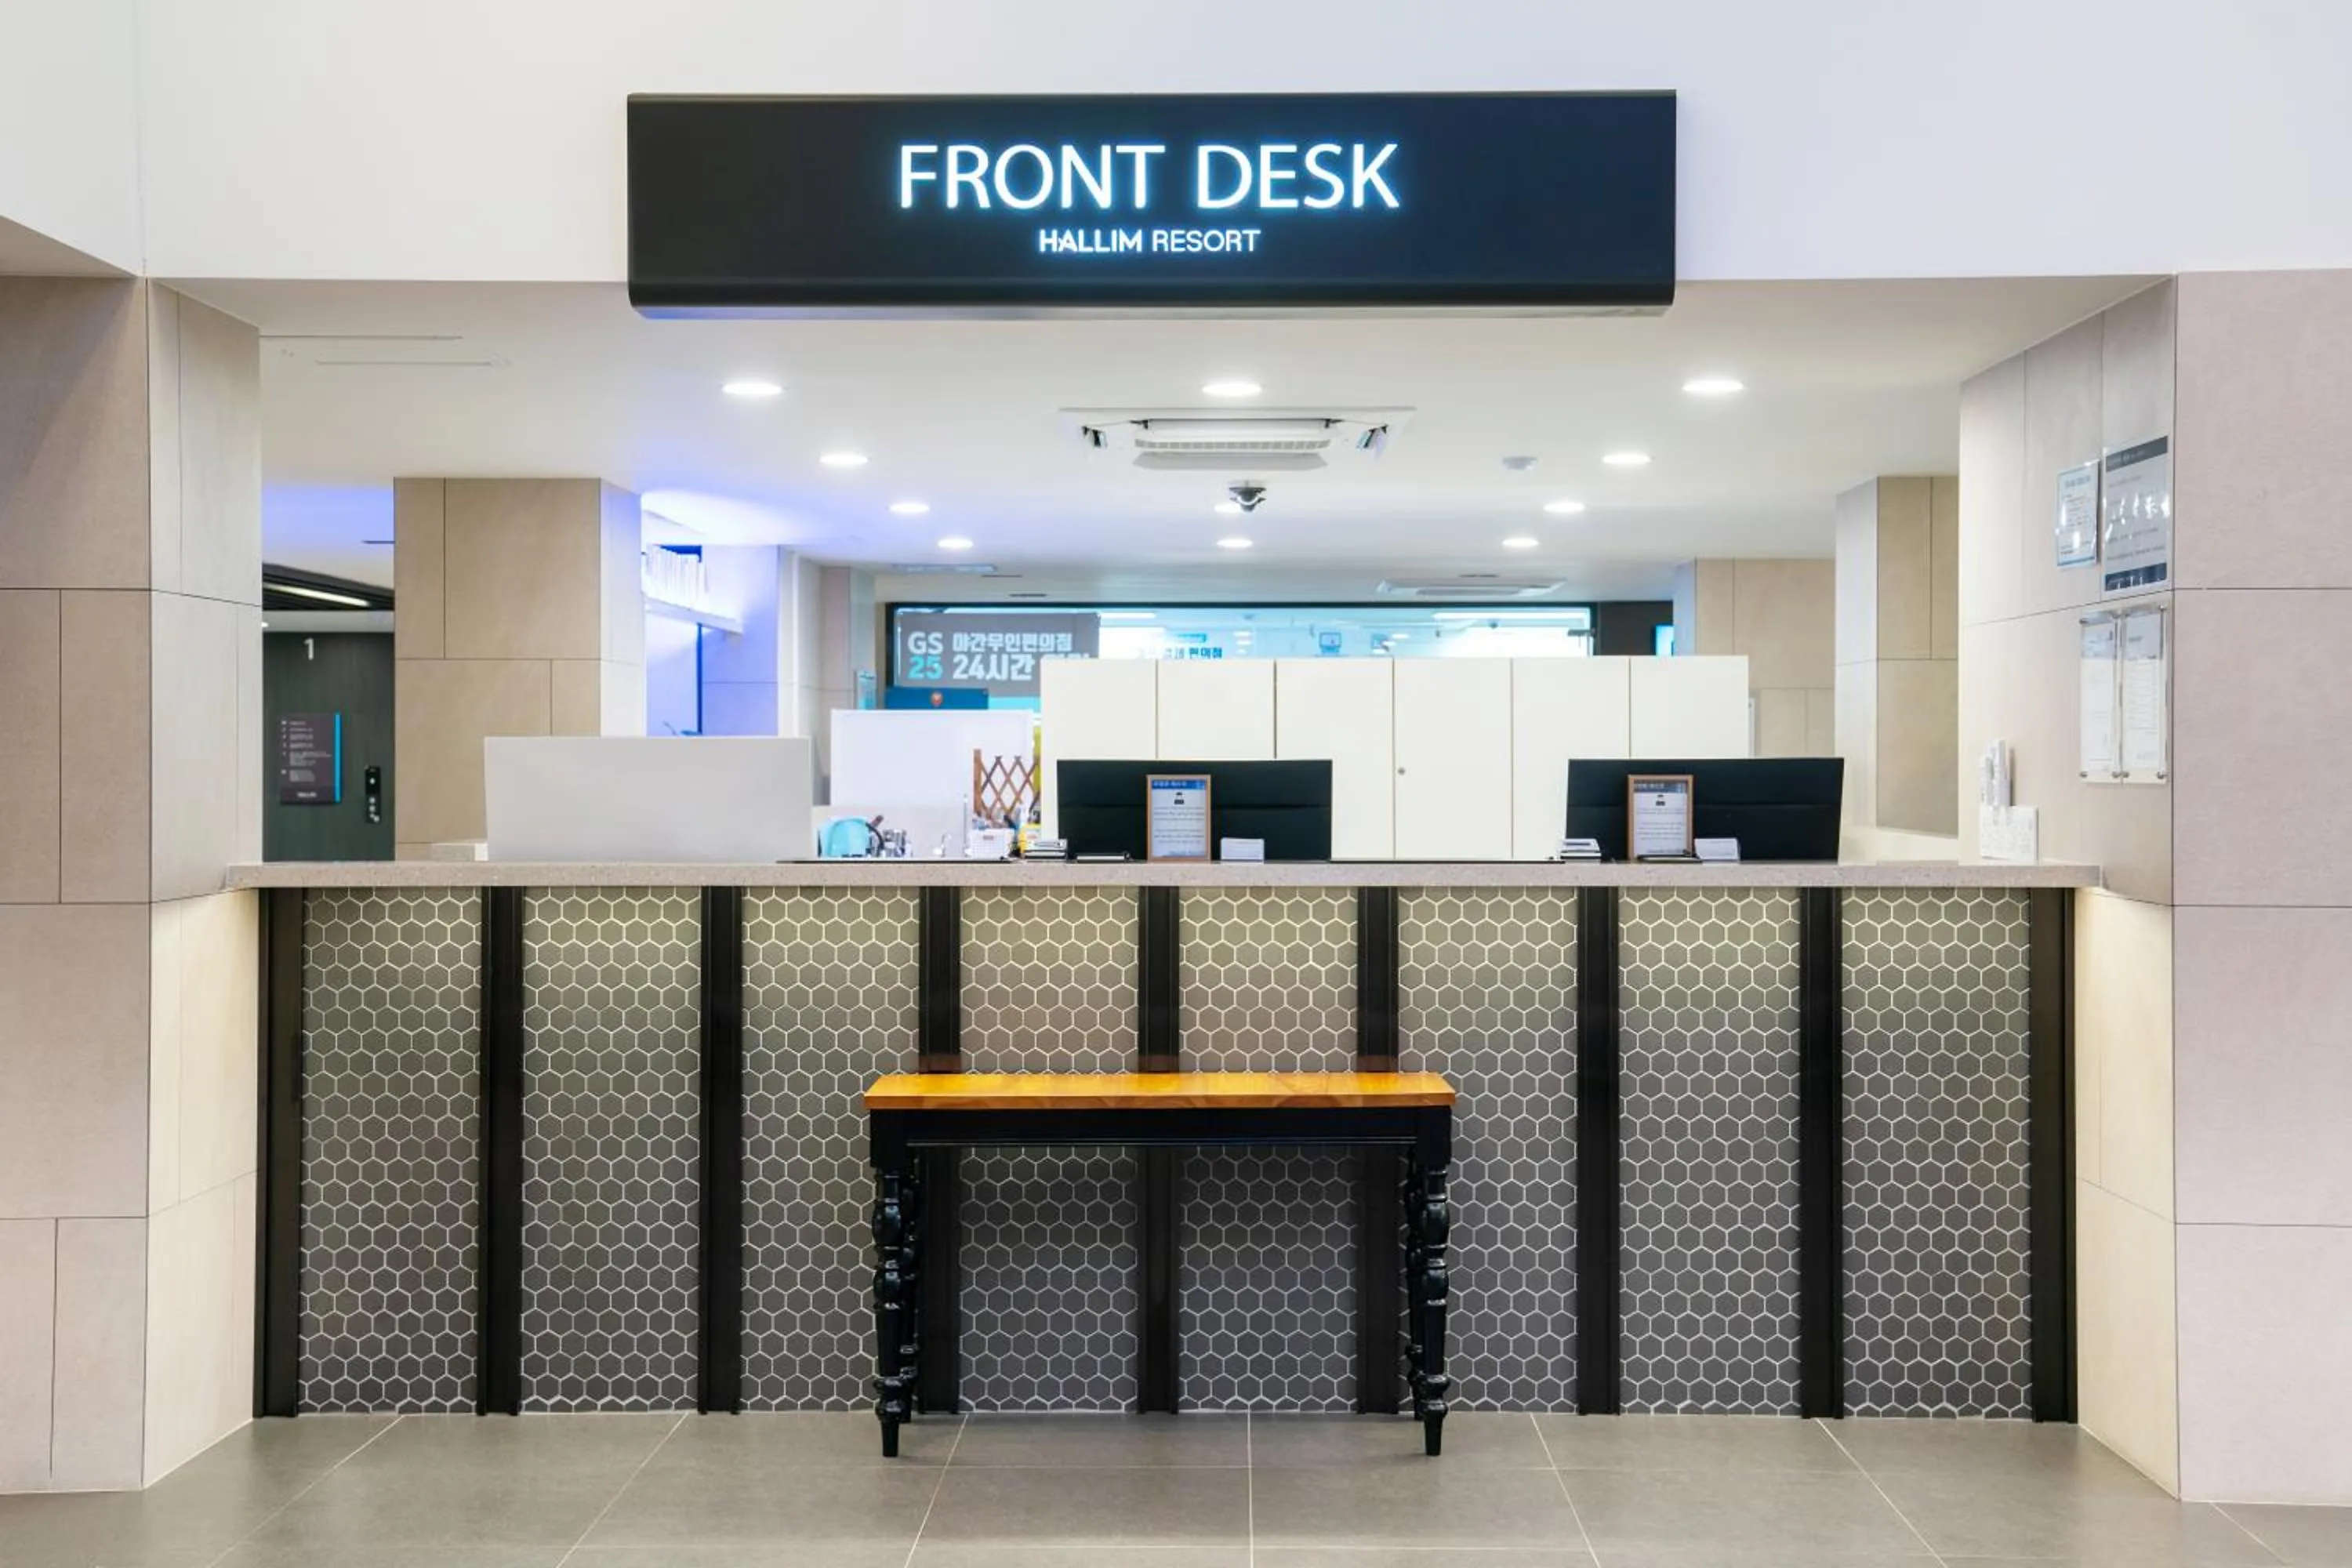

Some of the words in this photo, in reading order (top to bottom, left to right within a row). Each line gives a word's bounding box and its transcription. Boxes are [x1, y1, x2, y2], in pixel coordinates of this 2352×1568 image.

[899, 143, 1166, 209] FRONT
[1196, 143, 1400, 209] DESK
[1038, 229, 1143, 253] HALLIM
[1151, 229, 1261, 253] RESORT
[304, 637, 314, 661] 1
[908, 631, 943, 655] GS
[907, 655, 943, 681] 25
[952, 654, 1035, 681] 24시간
